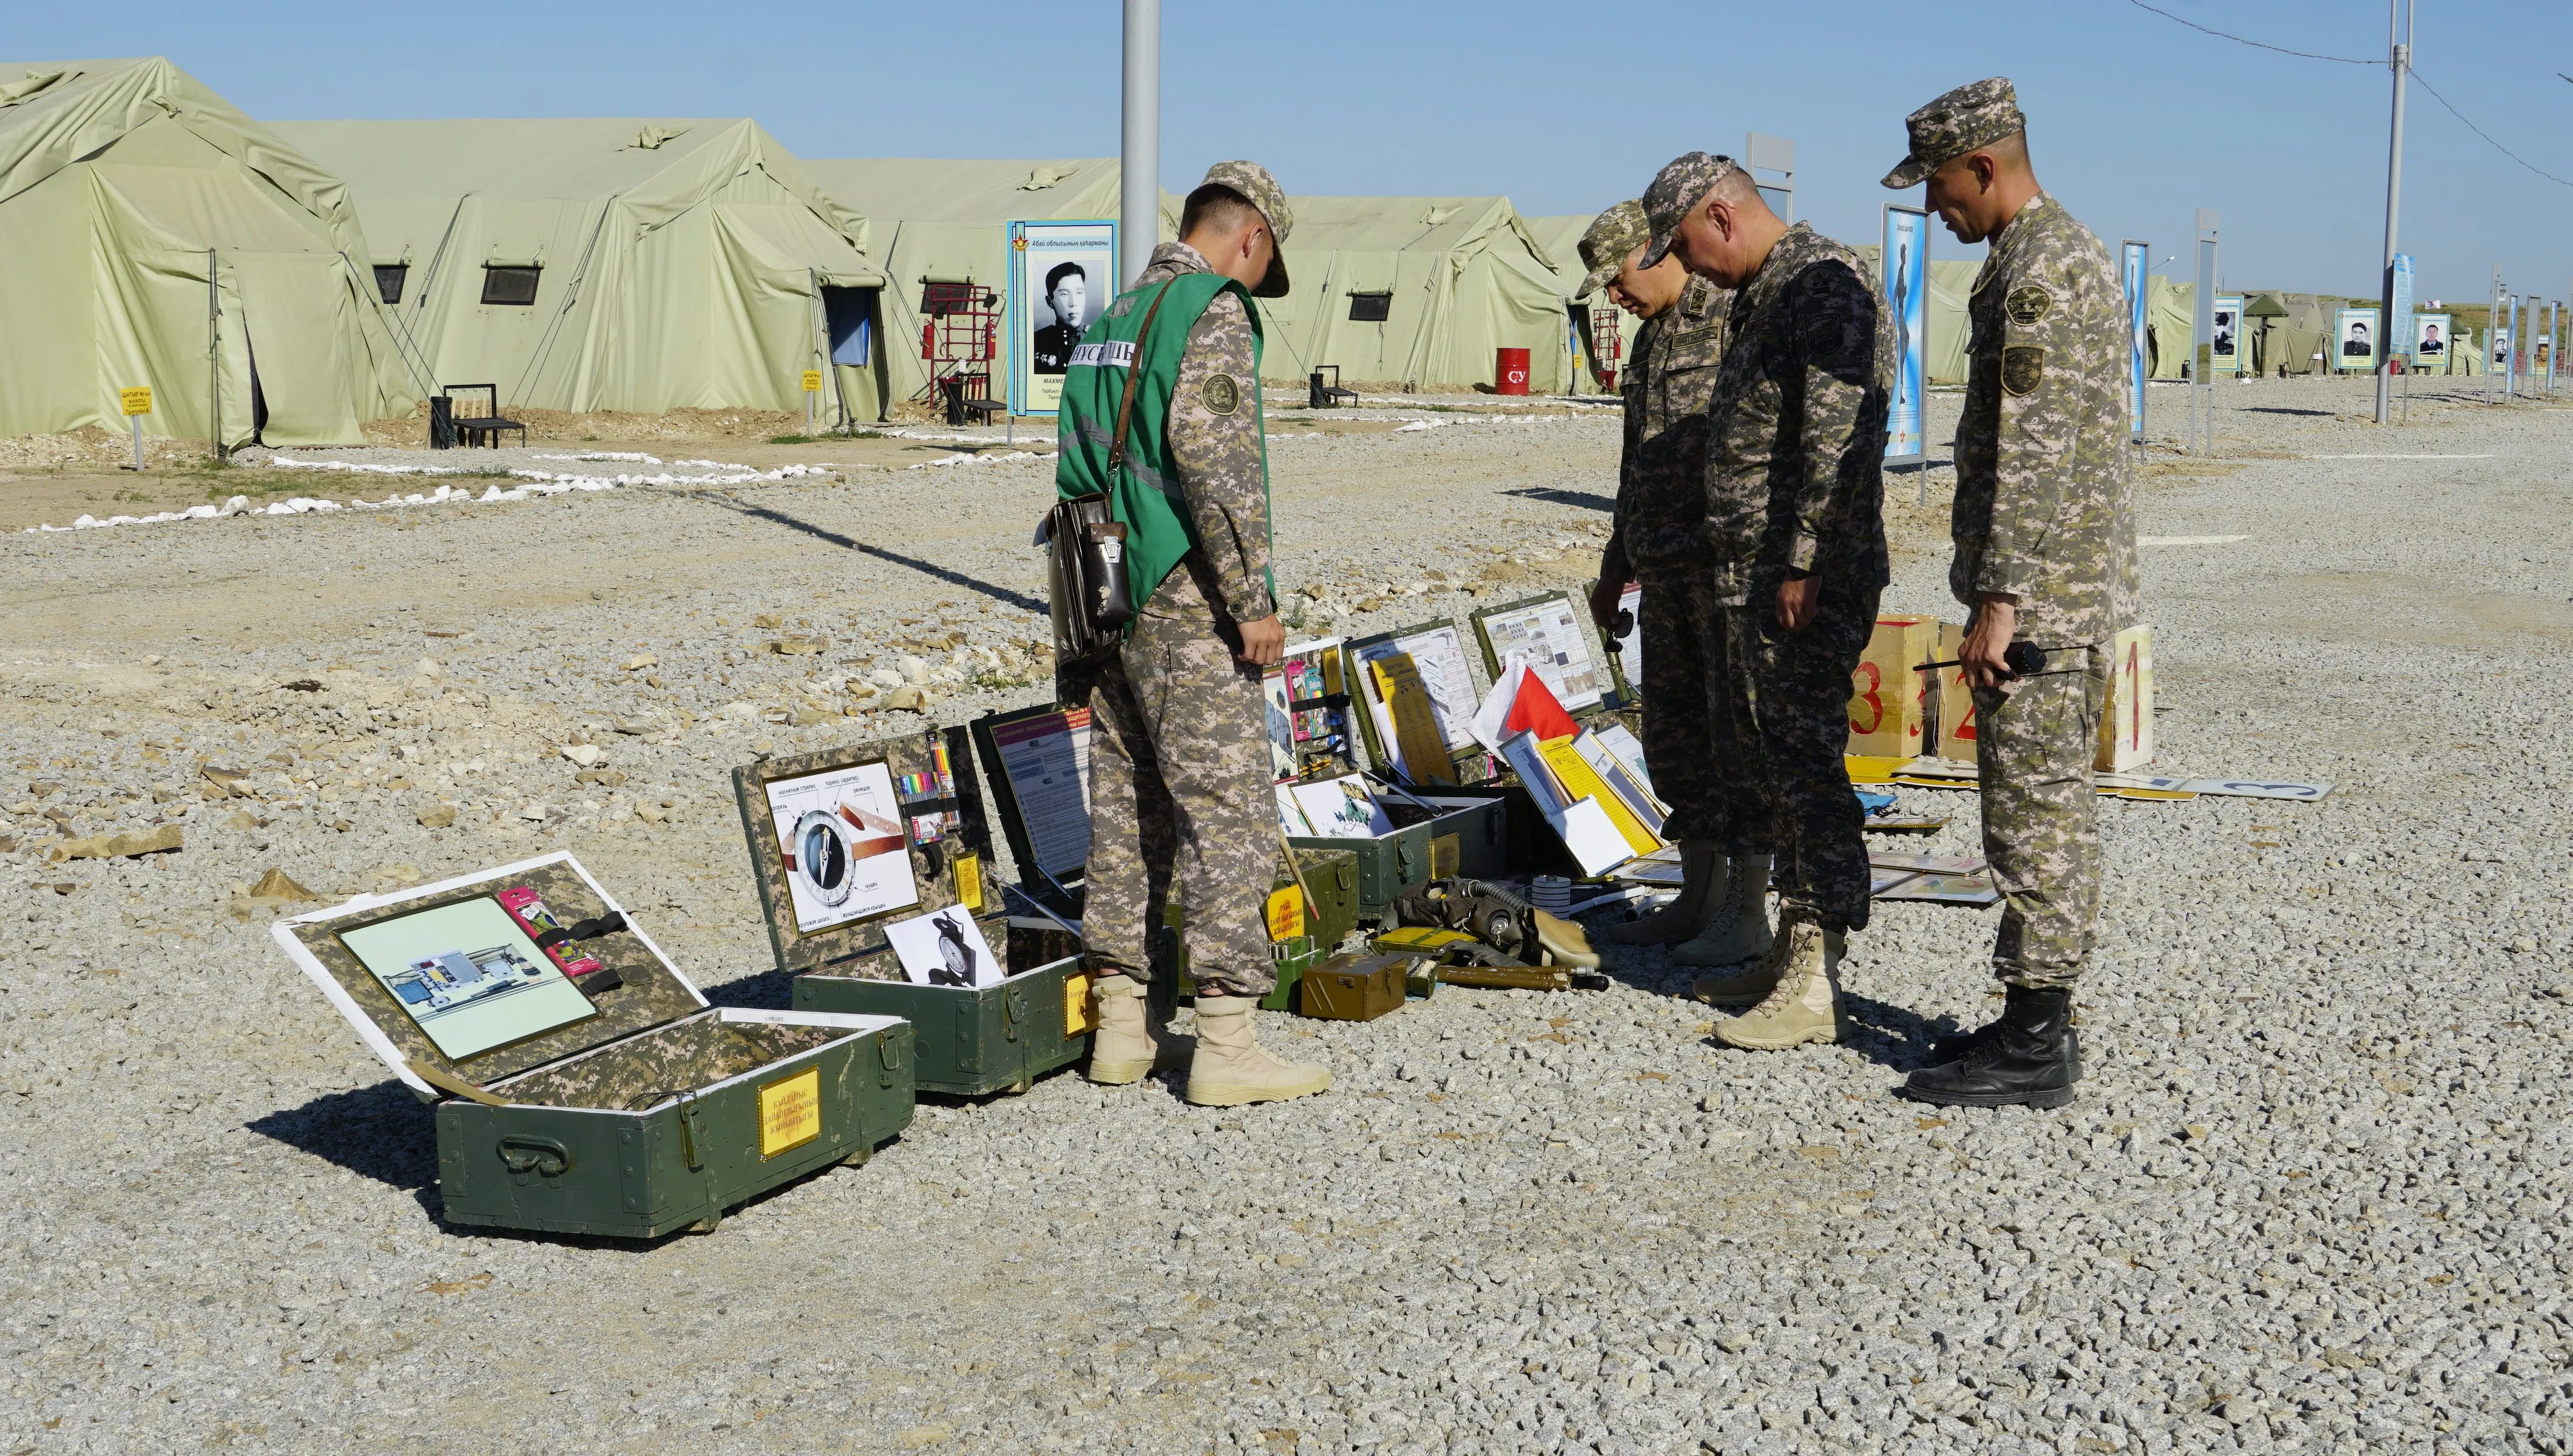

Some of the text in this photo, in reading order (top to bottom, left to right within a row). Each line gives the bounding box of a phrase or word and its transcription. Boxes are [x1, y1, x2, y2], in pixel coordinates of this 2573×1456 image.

[1850, 661, 1883, 735] 3
[2125, 641, 2139, 752] 1
[1066, 712, 1090, 723] ЗАЩИТНОГО
[840, 775, 859, 784] (арретир)
[779, 787, 799, 795] магнитная
[774, 1089, 808, 1109] БАЙЛАНЫС
